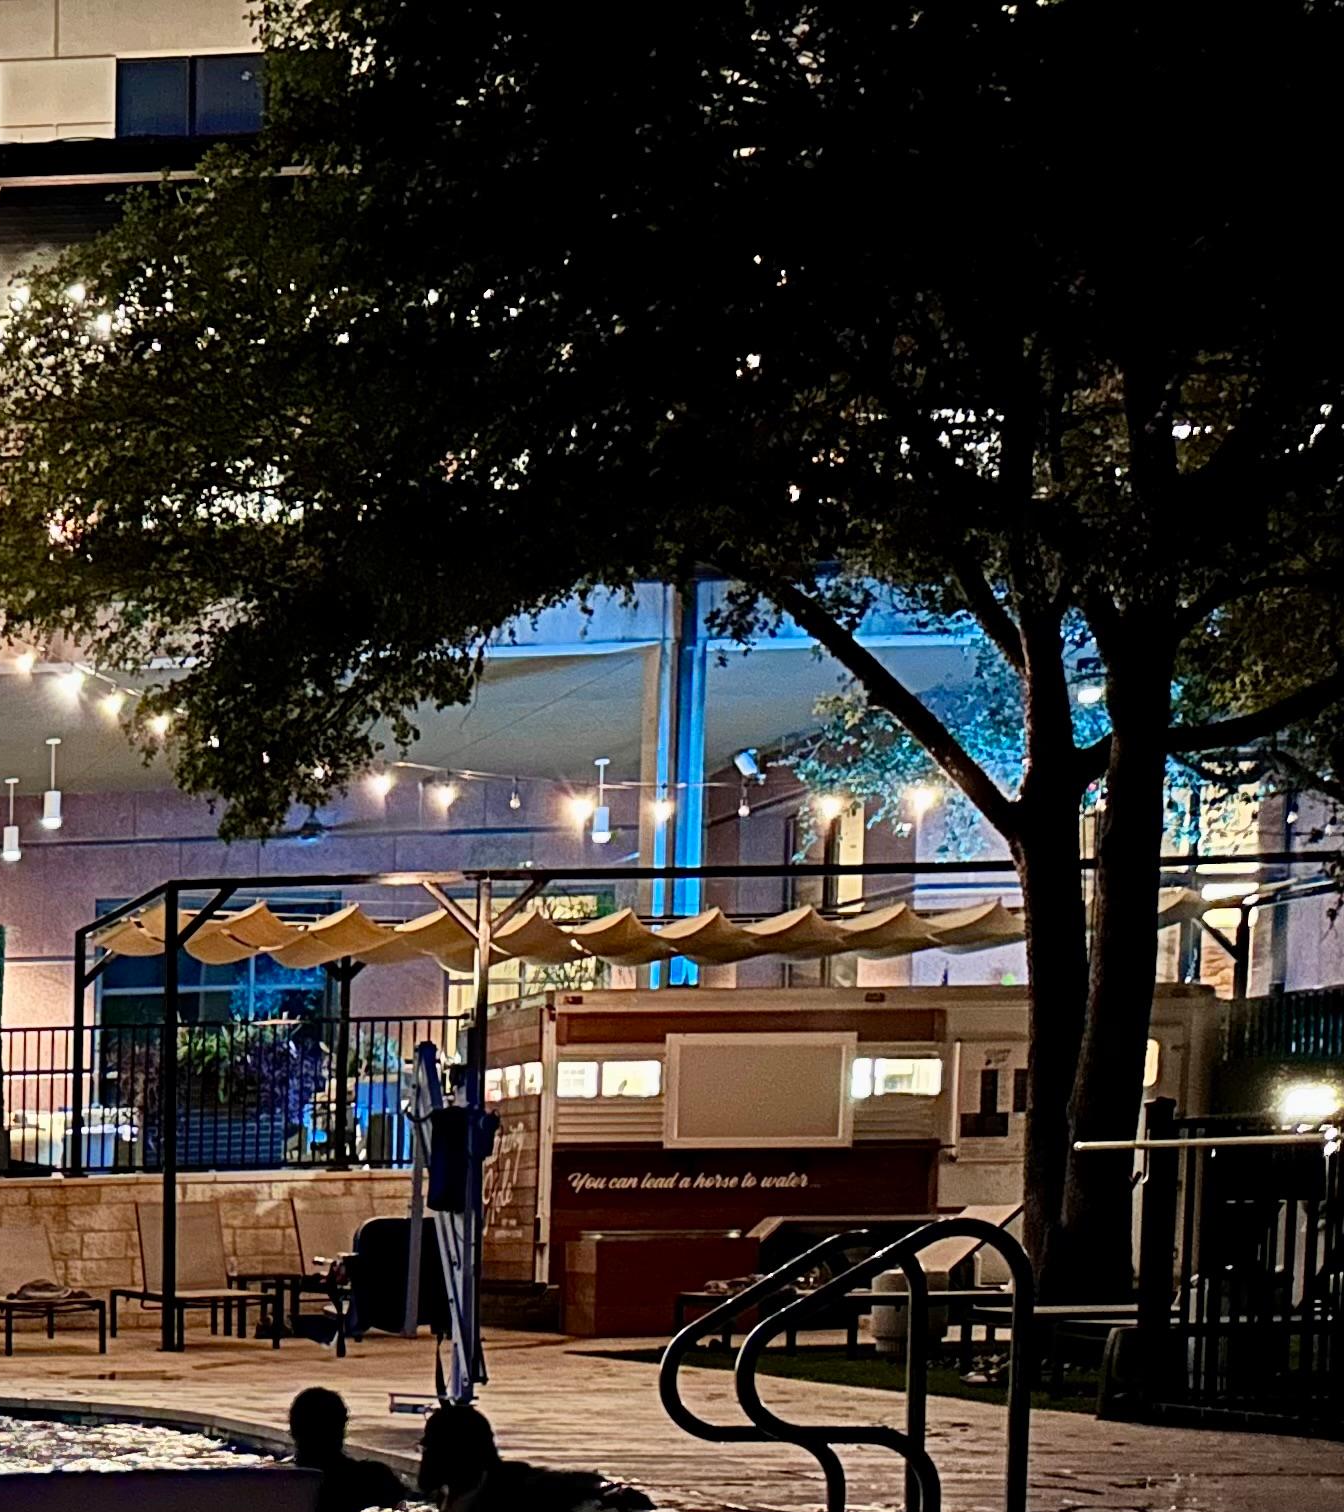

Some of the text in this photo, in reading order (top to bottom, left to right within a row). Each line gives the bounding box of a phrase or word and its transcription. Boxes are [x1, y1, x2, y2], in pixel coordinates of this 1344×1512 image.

[567, 1172, 607, 1194] You
[608, 1176, 638, 1189] can
[640, 1172, 680, 1189] lead
[679, 1176, 692, 1189] a
[693, 1172, 739, 1189] horse
[740, 1172, 757, 1188] to
